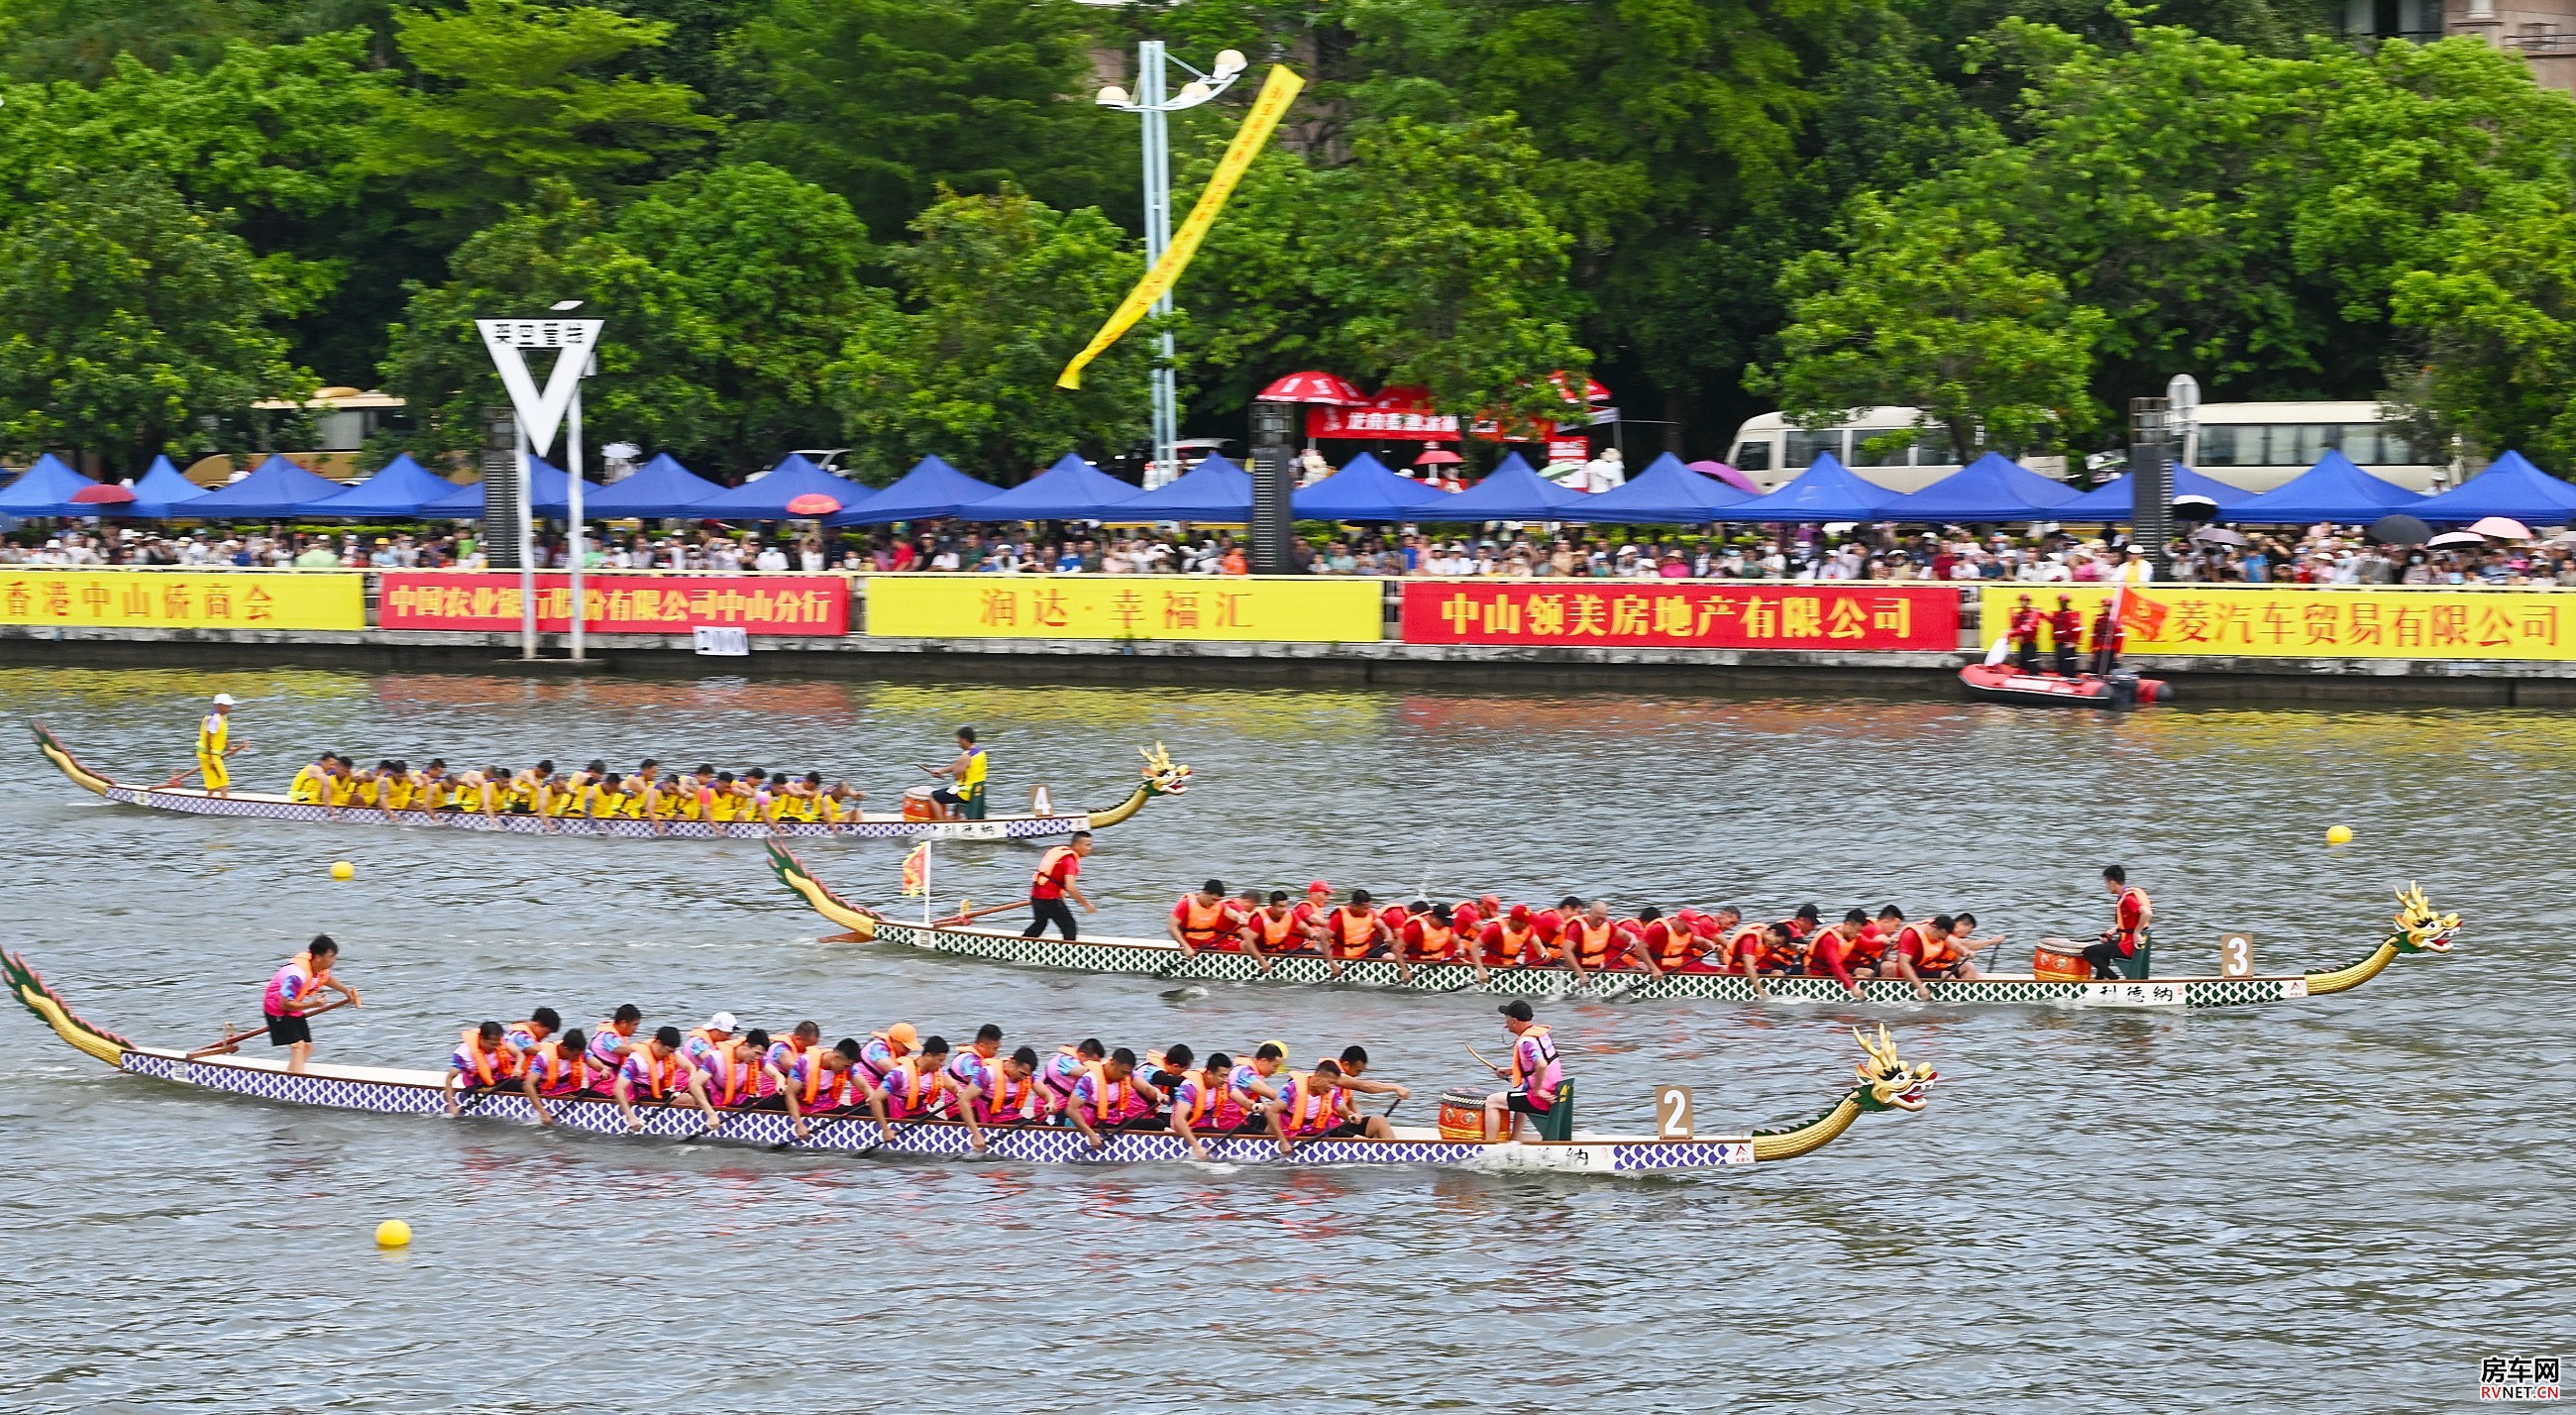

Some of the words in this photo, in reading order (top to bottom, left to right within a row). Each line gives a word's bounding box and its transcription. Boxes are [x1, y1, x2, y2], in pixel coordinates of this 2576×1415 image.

[3, 581, 273, 621] 香港中山侨商会
[1441, 593, 1912, 640] 中山领美房地产有限公司
[1033, 786, 1052, 816] 4
[2227, 936, 2249, 976] 3
[1664, 1089, 1688, 1136] 2
